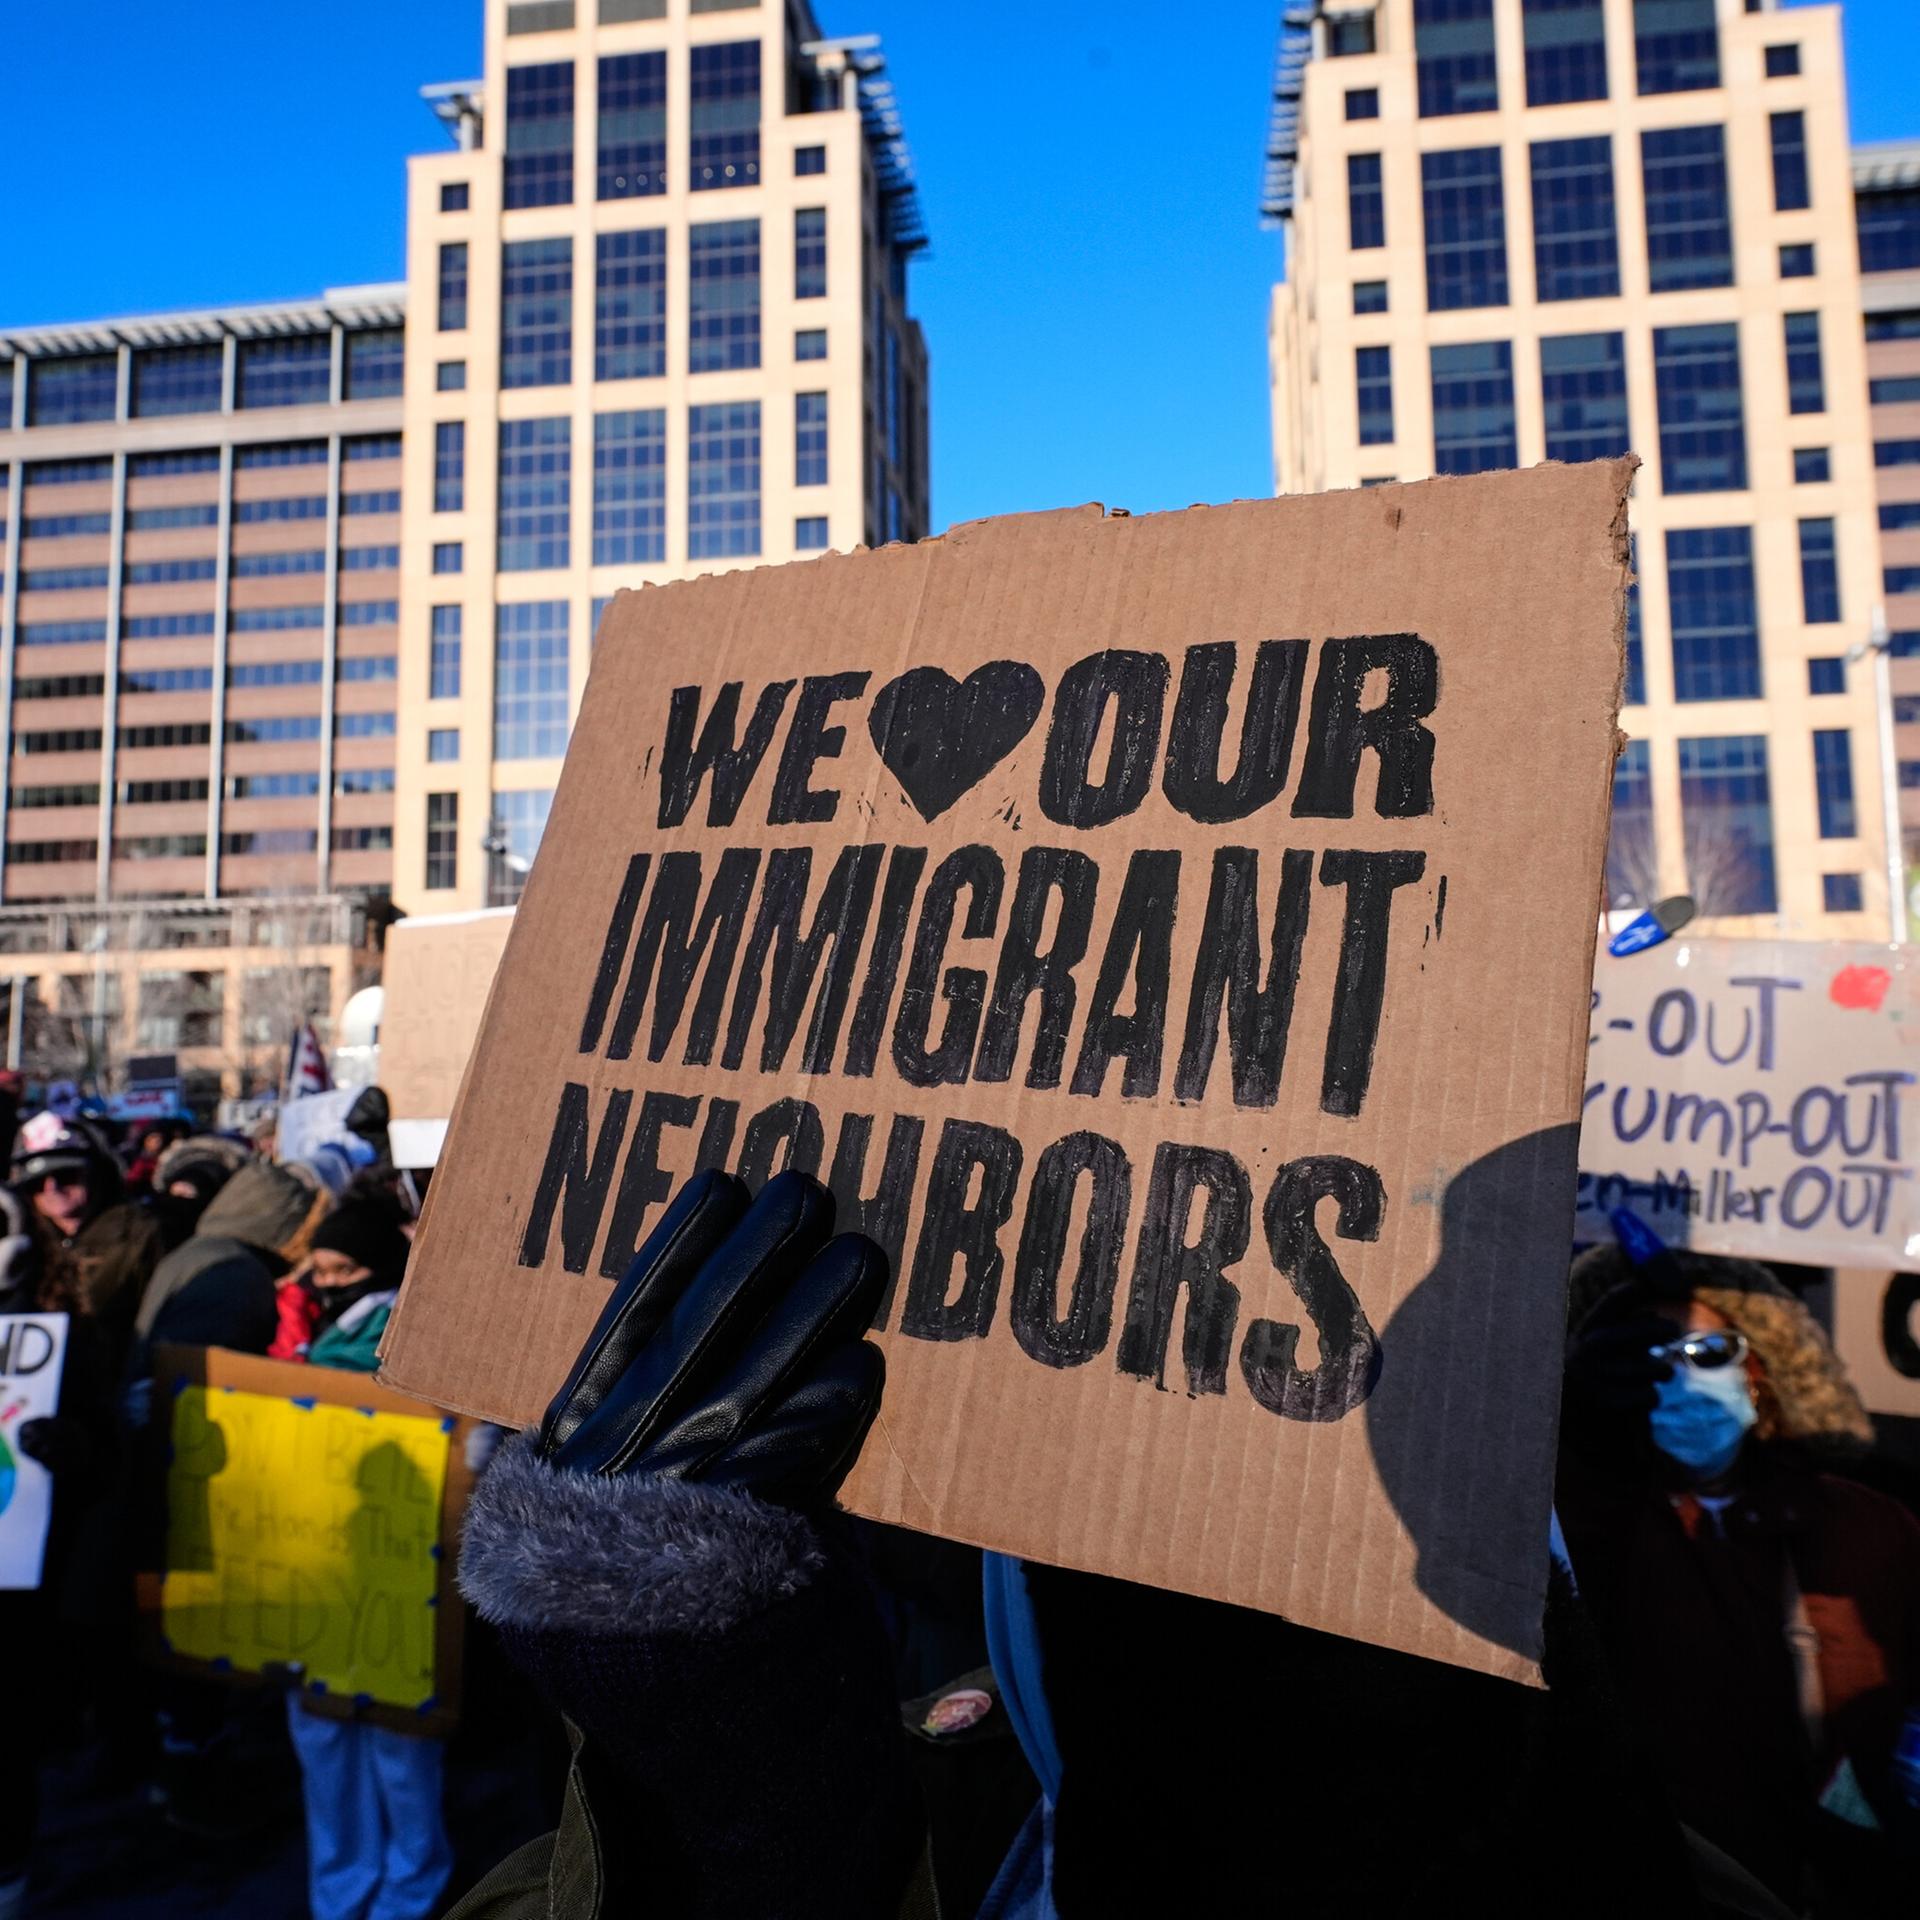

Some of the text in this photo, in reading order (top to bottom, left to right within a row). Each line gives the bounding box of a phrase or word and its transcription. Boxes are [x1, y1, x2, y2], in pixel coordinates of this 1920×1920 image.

[657, 633, 1438, 830] WE OUR
[579, 843, 1427, 1118] IMMIGRANT
[1780, 1166, 1913, 1234] OUT
